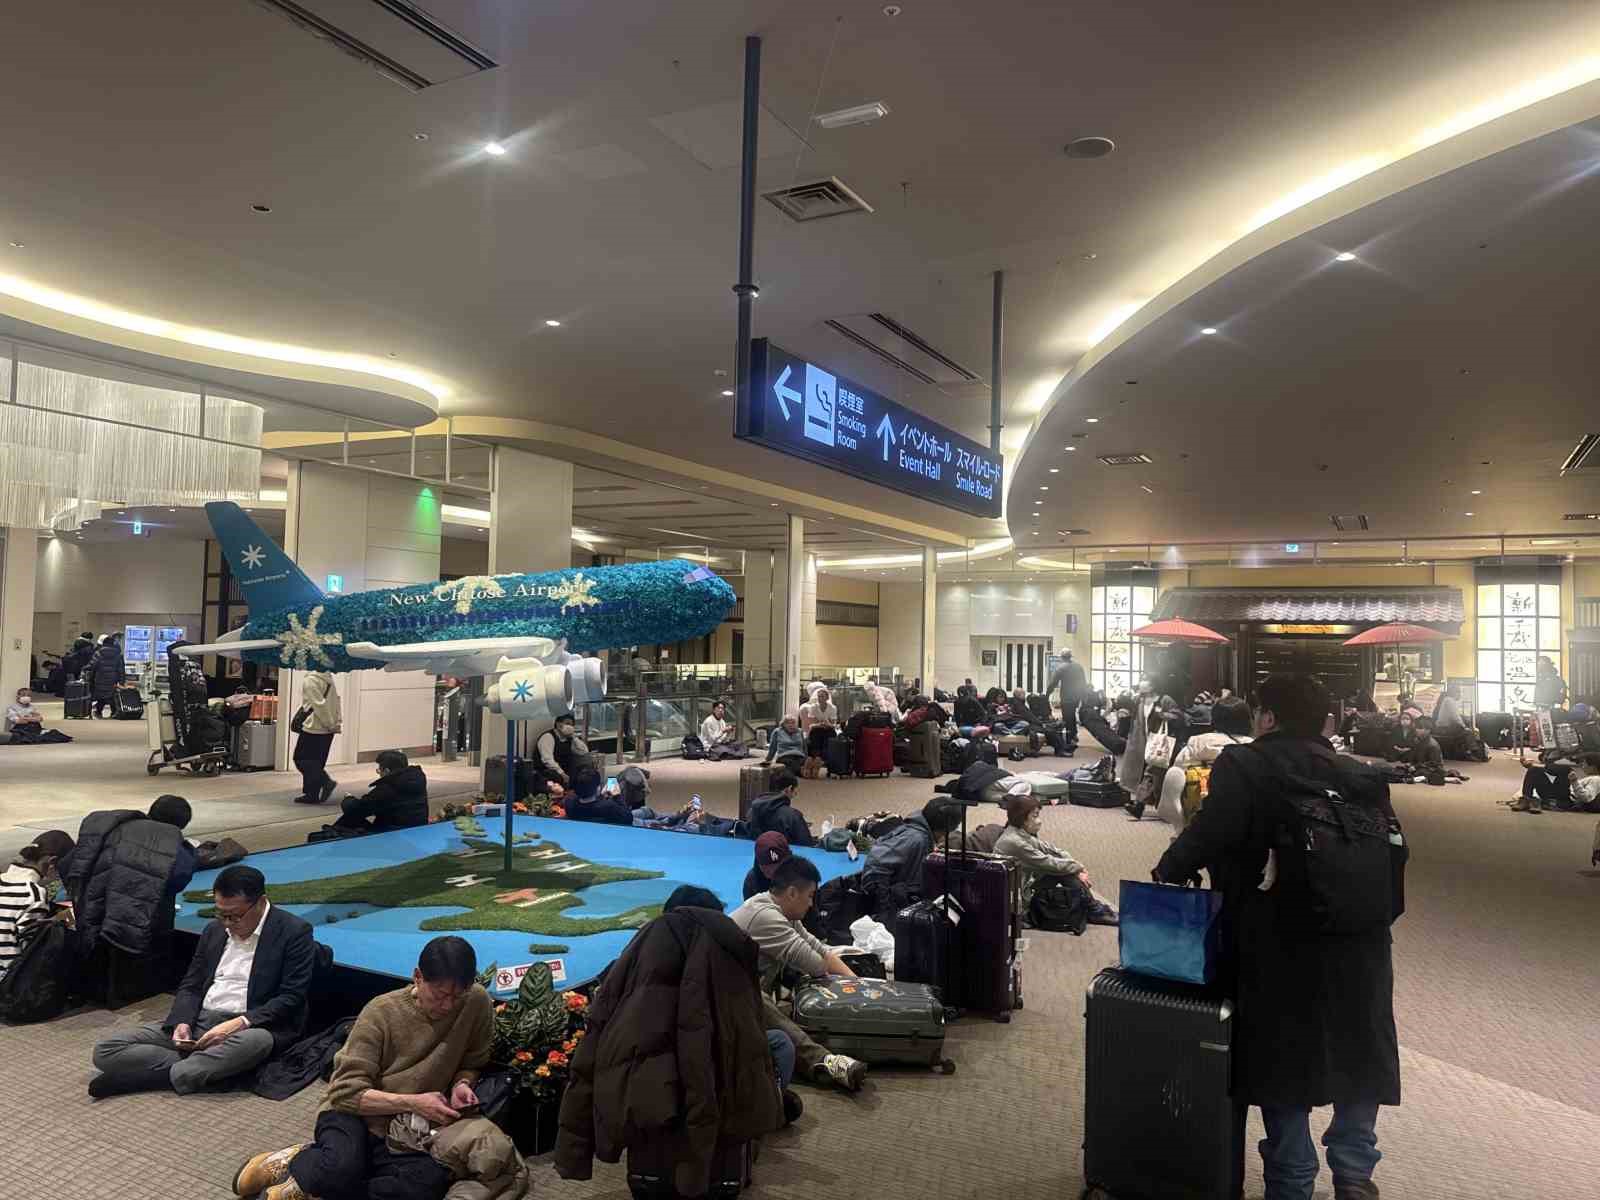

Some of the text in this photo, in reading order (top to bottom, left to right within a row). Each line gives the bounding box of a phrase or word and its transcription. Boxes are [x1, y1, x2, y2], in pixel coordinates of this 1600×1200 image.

[838, 388, 865, 416] 喫煙室
[837, 410, 866, 438] Smoking
[837, 429, 857, 451] Room
[900, 423, 952, 465] イベントホール
[899, 449, 941, 481] Event Hall
[956, 472, 993, 500] Smile Road
[389, 582, 588, 607] New Chitose Airport
